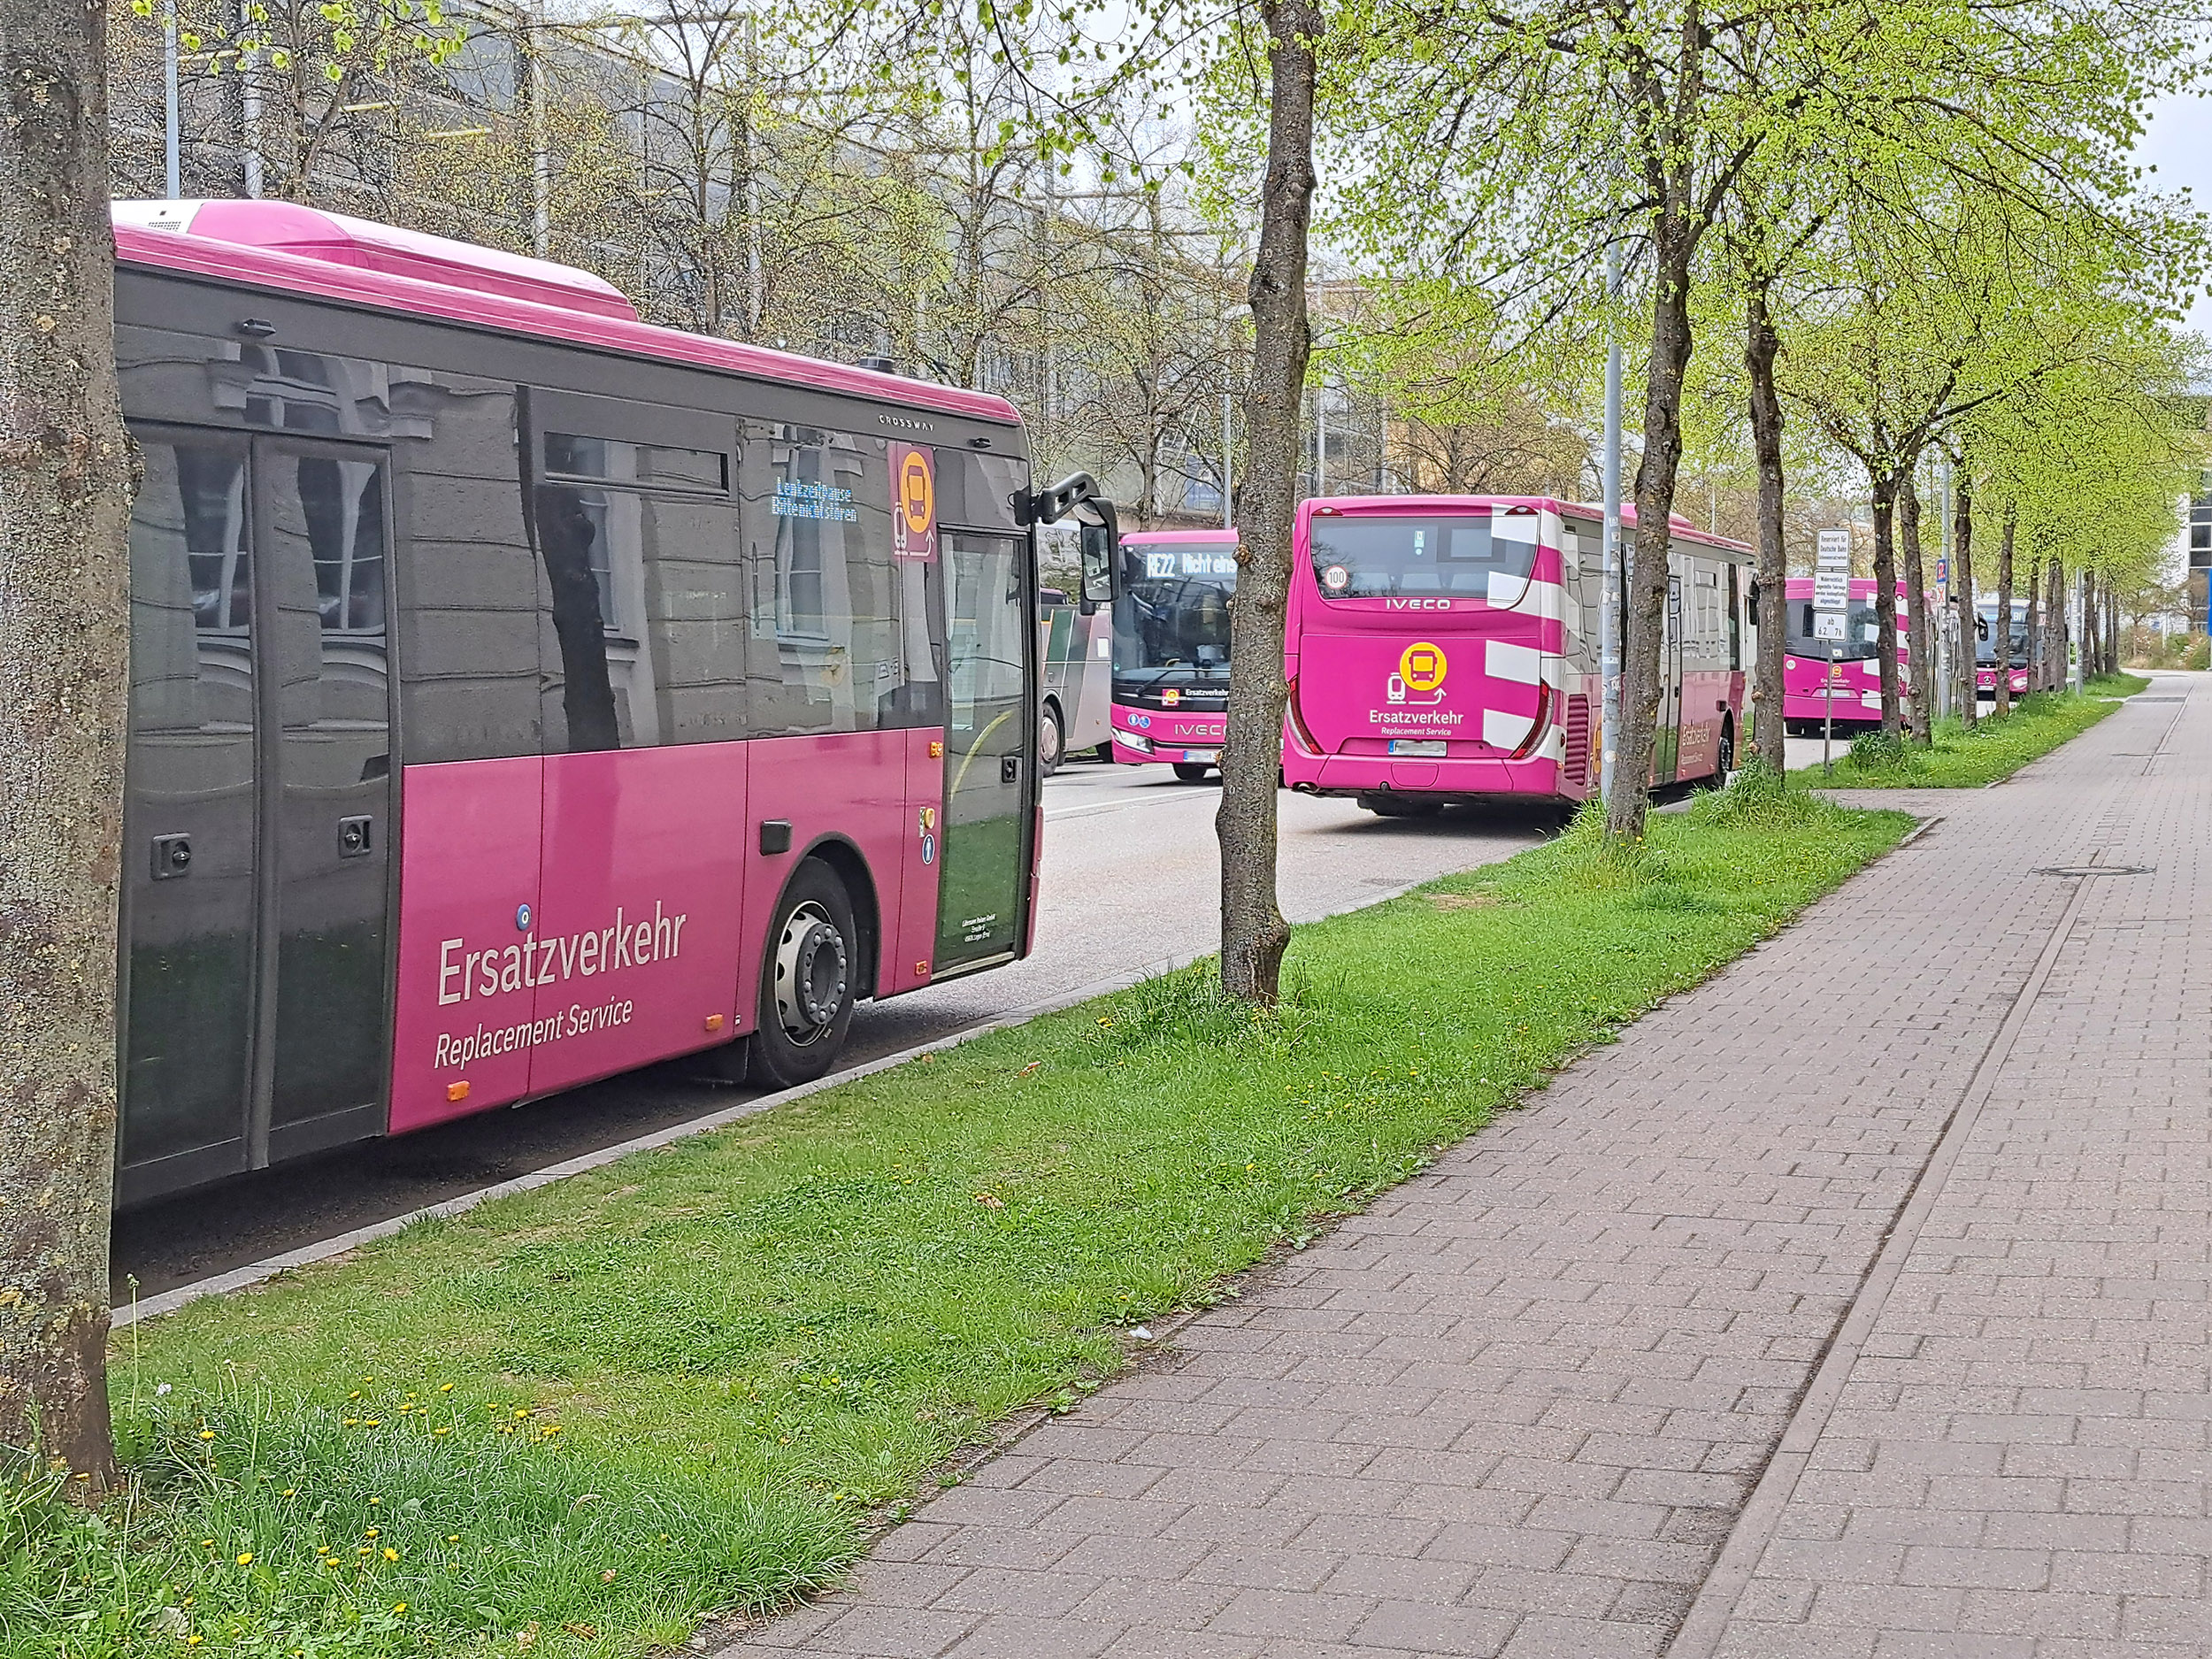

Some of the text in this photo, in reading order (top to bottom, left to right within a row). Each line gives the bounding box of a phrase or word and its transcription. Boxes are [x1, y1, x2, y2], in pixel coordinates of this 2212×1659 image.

[879, 414, 934, 432] CROSSWAY
[1147, 553, 1176, 578] RE22
[1182, 553, 1212, 574] Nicht
[1329, 572, 1345, 584] 100
[1386, 599, 1451, 610] IVECO
[1370, 710, 1464, 725] Ersatzverkehr
[1381, 726, 1452, 736] Replacement Service
[438, 900, 687, 1006] Ersatzverkehr
[434, 995, 633, 1071] Replacement Service
